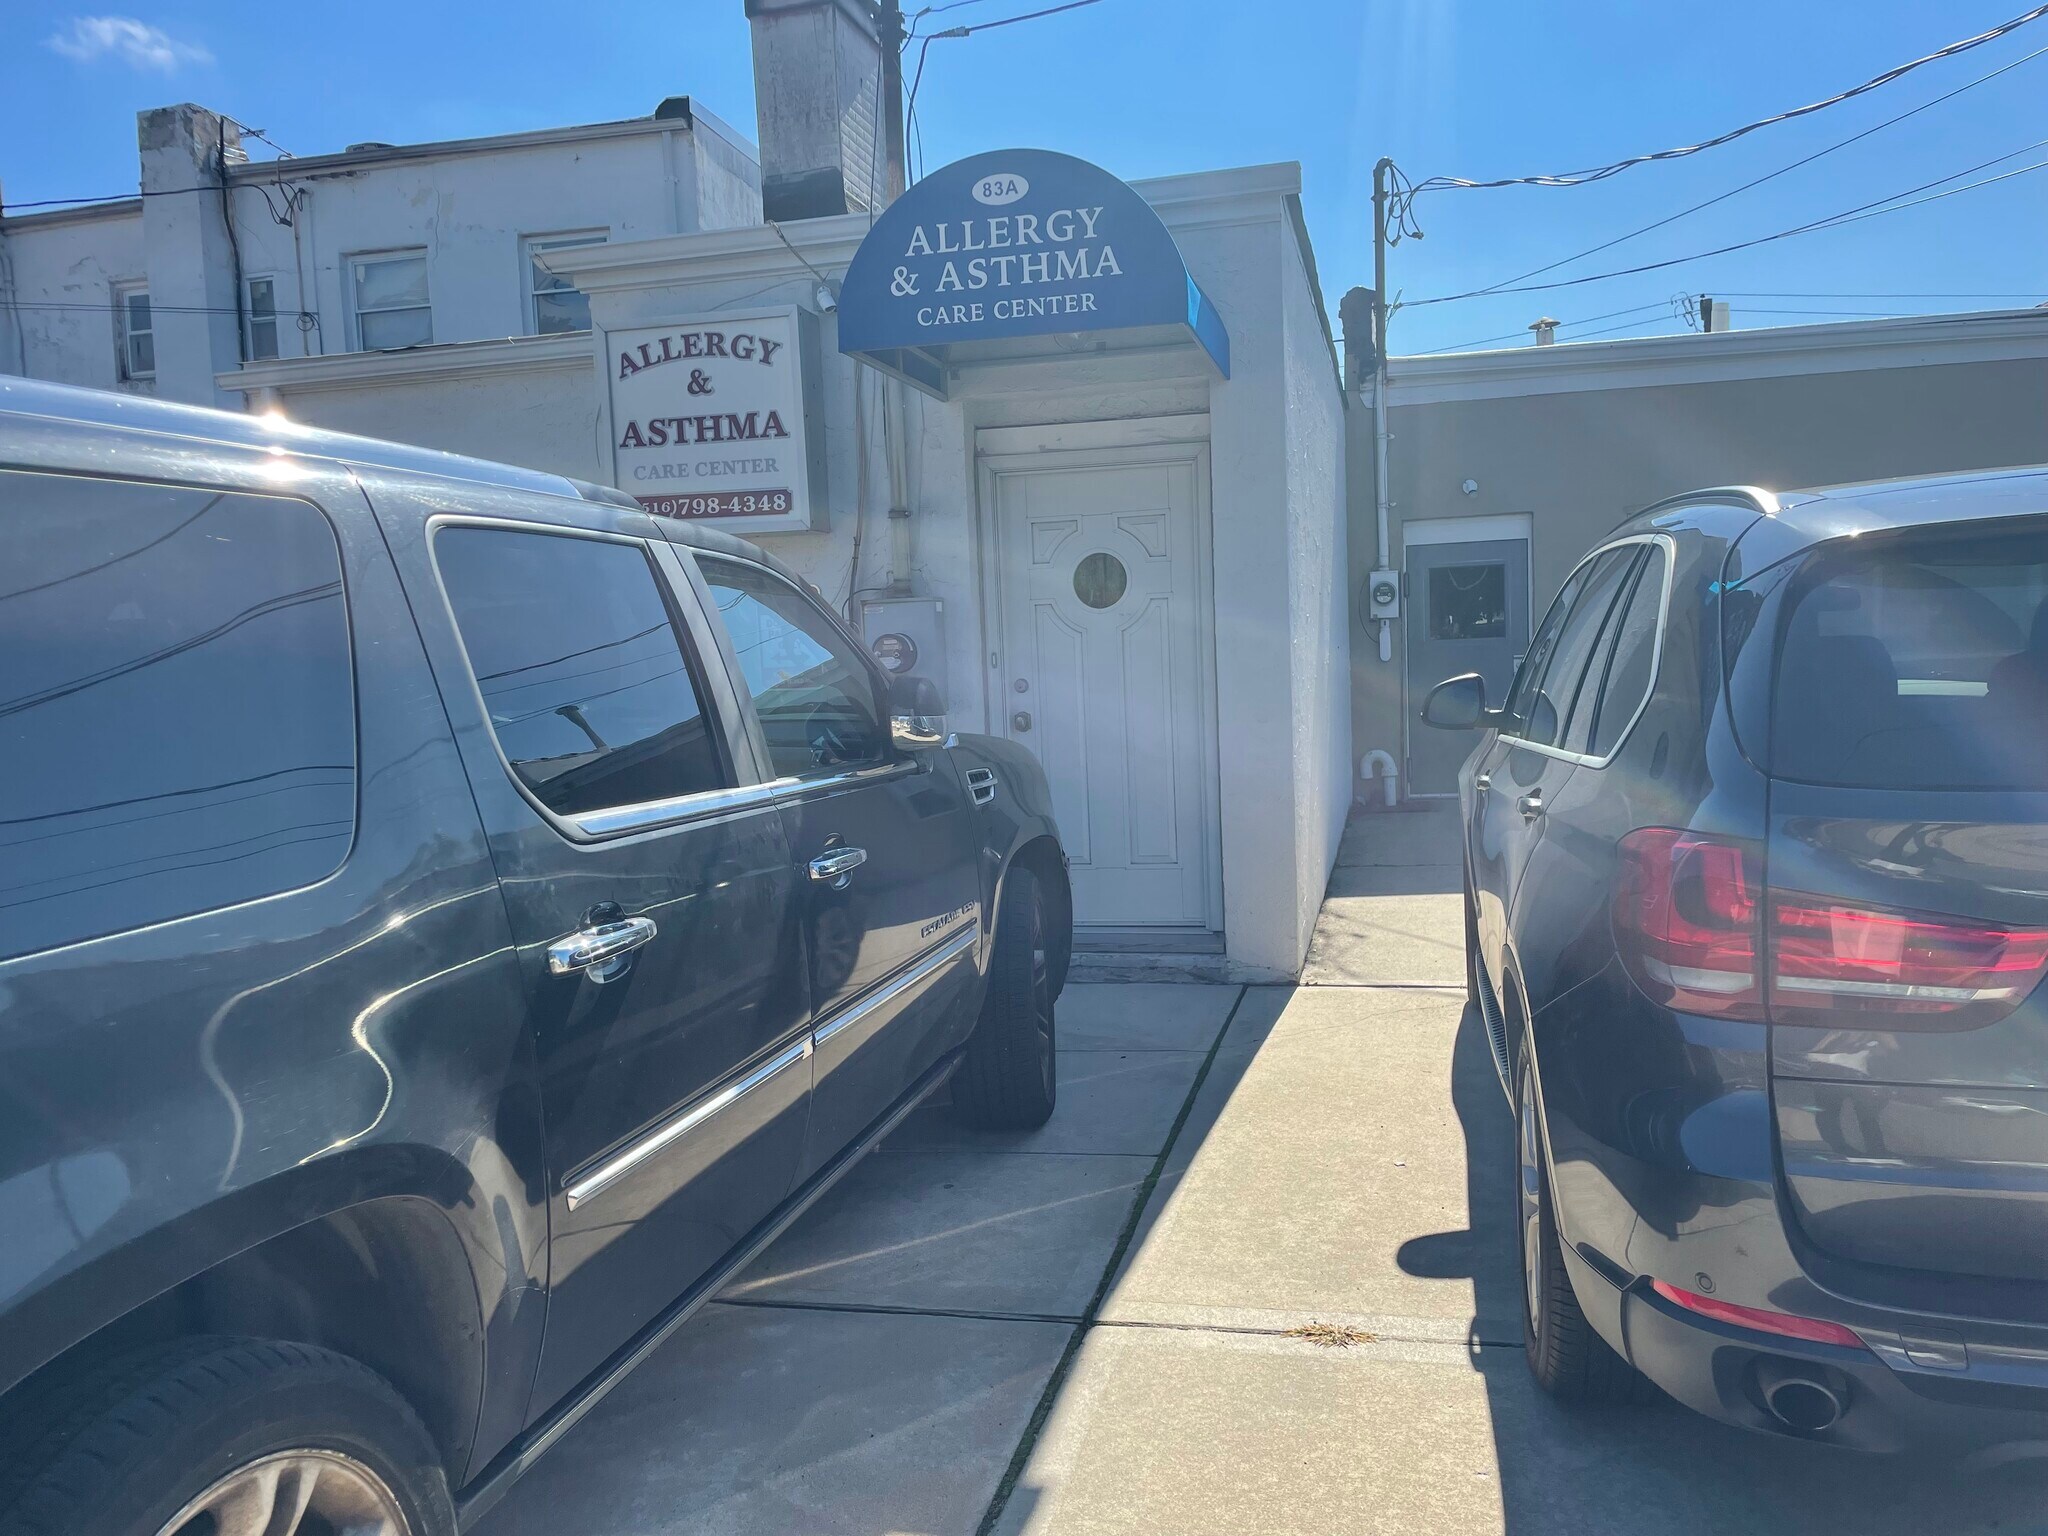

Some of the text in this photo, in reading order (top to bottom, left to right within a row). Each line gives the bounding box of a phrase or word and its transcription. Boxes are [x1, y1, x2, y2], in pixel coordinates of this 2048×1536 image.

[981, 180, 1019, 199] 83A
[904, 206, 1104, 257] ALLERGY
[890, 245, 1123, 297] & ASTHMA
[917, 292, 1098, 327] CARE CENTER
[618, 331, 782, 381] ALLERGY
[687, 368, 713, 396] &
[619, 410, 790, 448] ASTHMA
[633, 457, 779, 481] CARE CENTER
[643, 493, 787, 515] 516)798-4348
